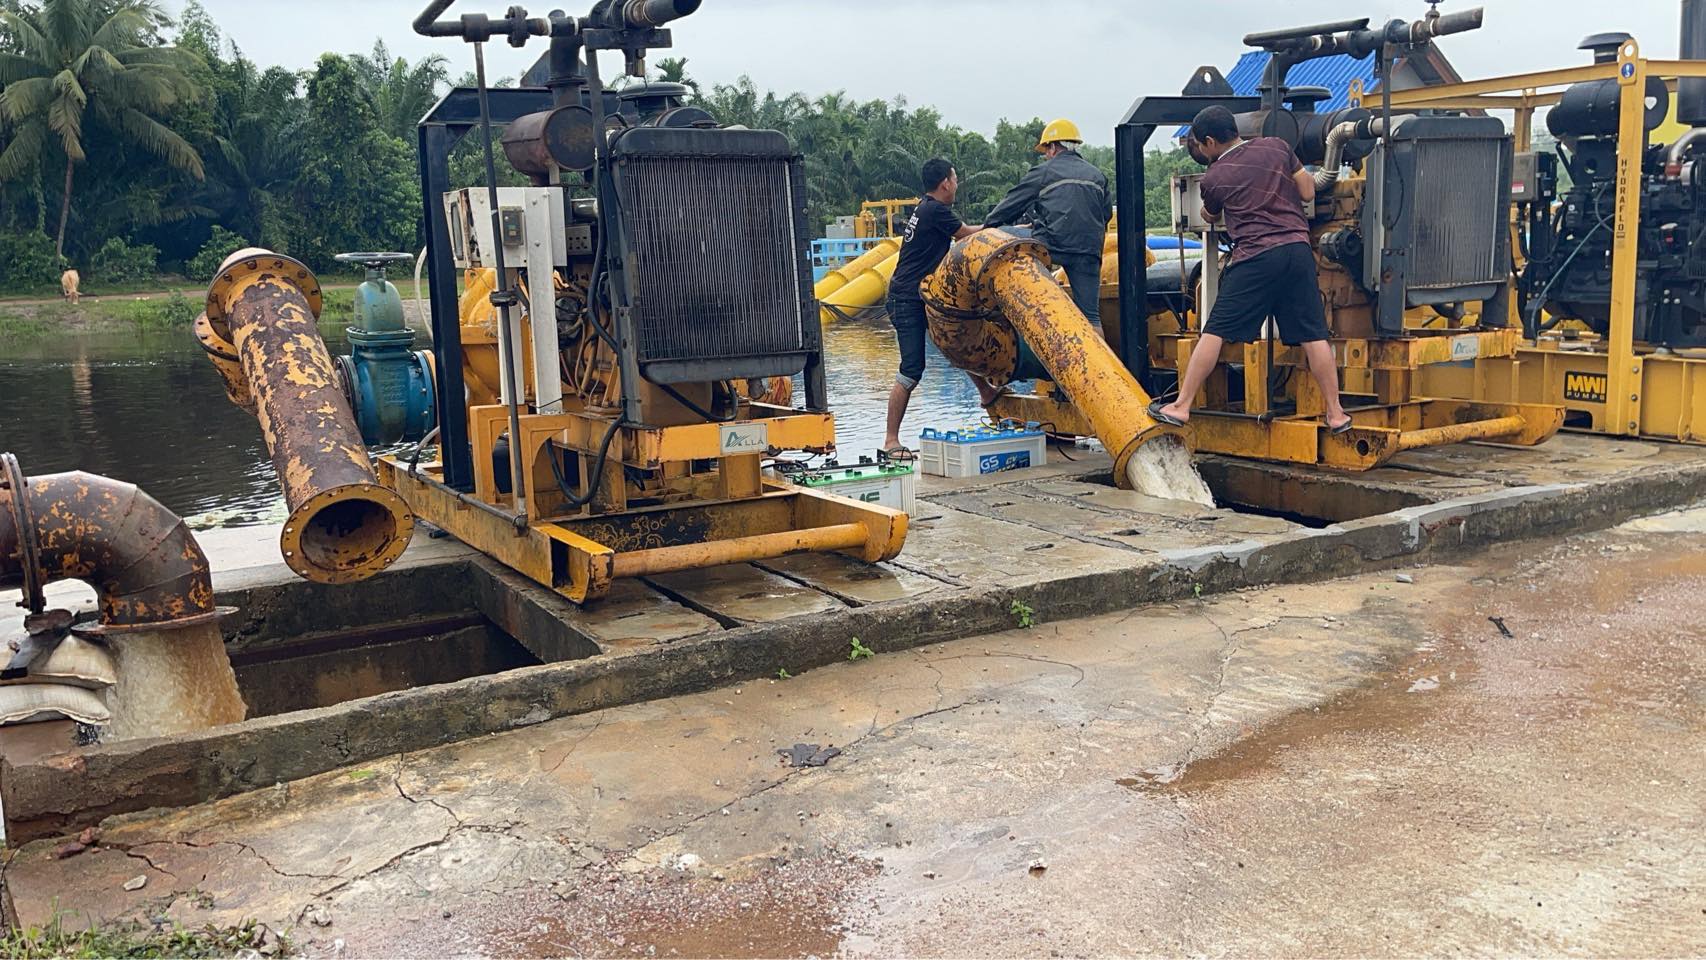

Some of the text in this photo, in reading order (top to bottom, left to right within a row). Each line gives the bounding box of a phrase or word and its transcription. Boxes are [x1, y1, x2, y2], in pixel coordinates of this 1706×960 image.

[1617, 159, 1627, 231] HYDRAFLO
[1567, 374, 1606, 394] MWI
[980, 455, 1000, 470] GS
